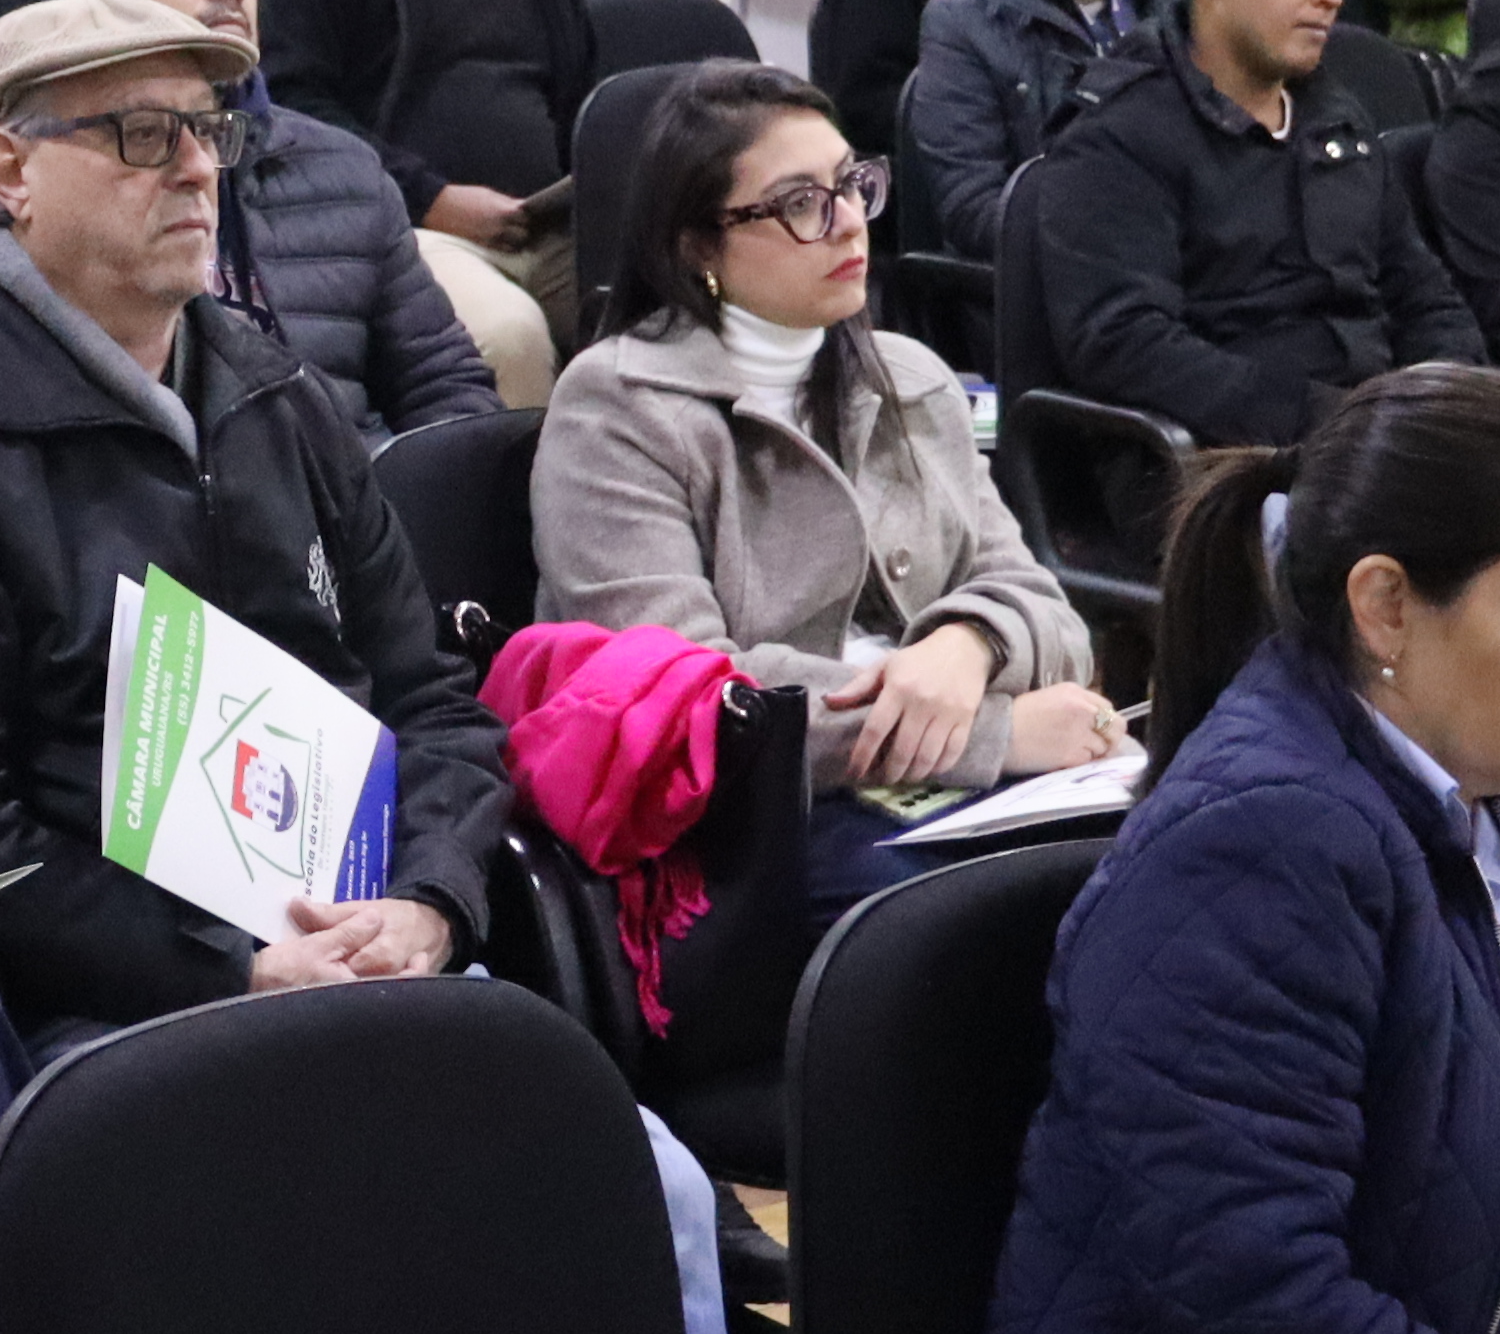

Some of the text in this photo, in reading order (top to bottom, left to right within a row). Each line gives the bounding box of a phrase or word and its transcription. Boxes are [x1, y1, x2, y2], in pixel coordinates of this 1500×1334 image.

[126, 613, 168, 831] CÂMARA MUNICIPAL
[151, 670, 174, 788] URUGUAIANA/RS
[303, 728, 324, 897] scola do Legislativo
